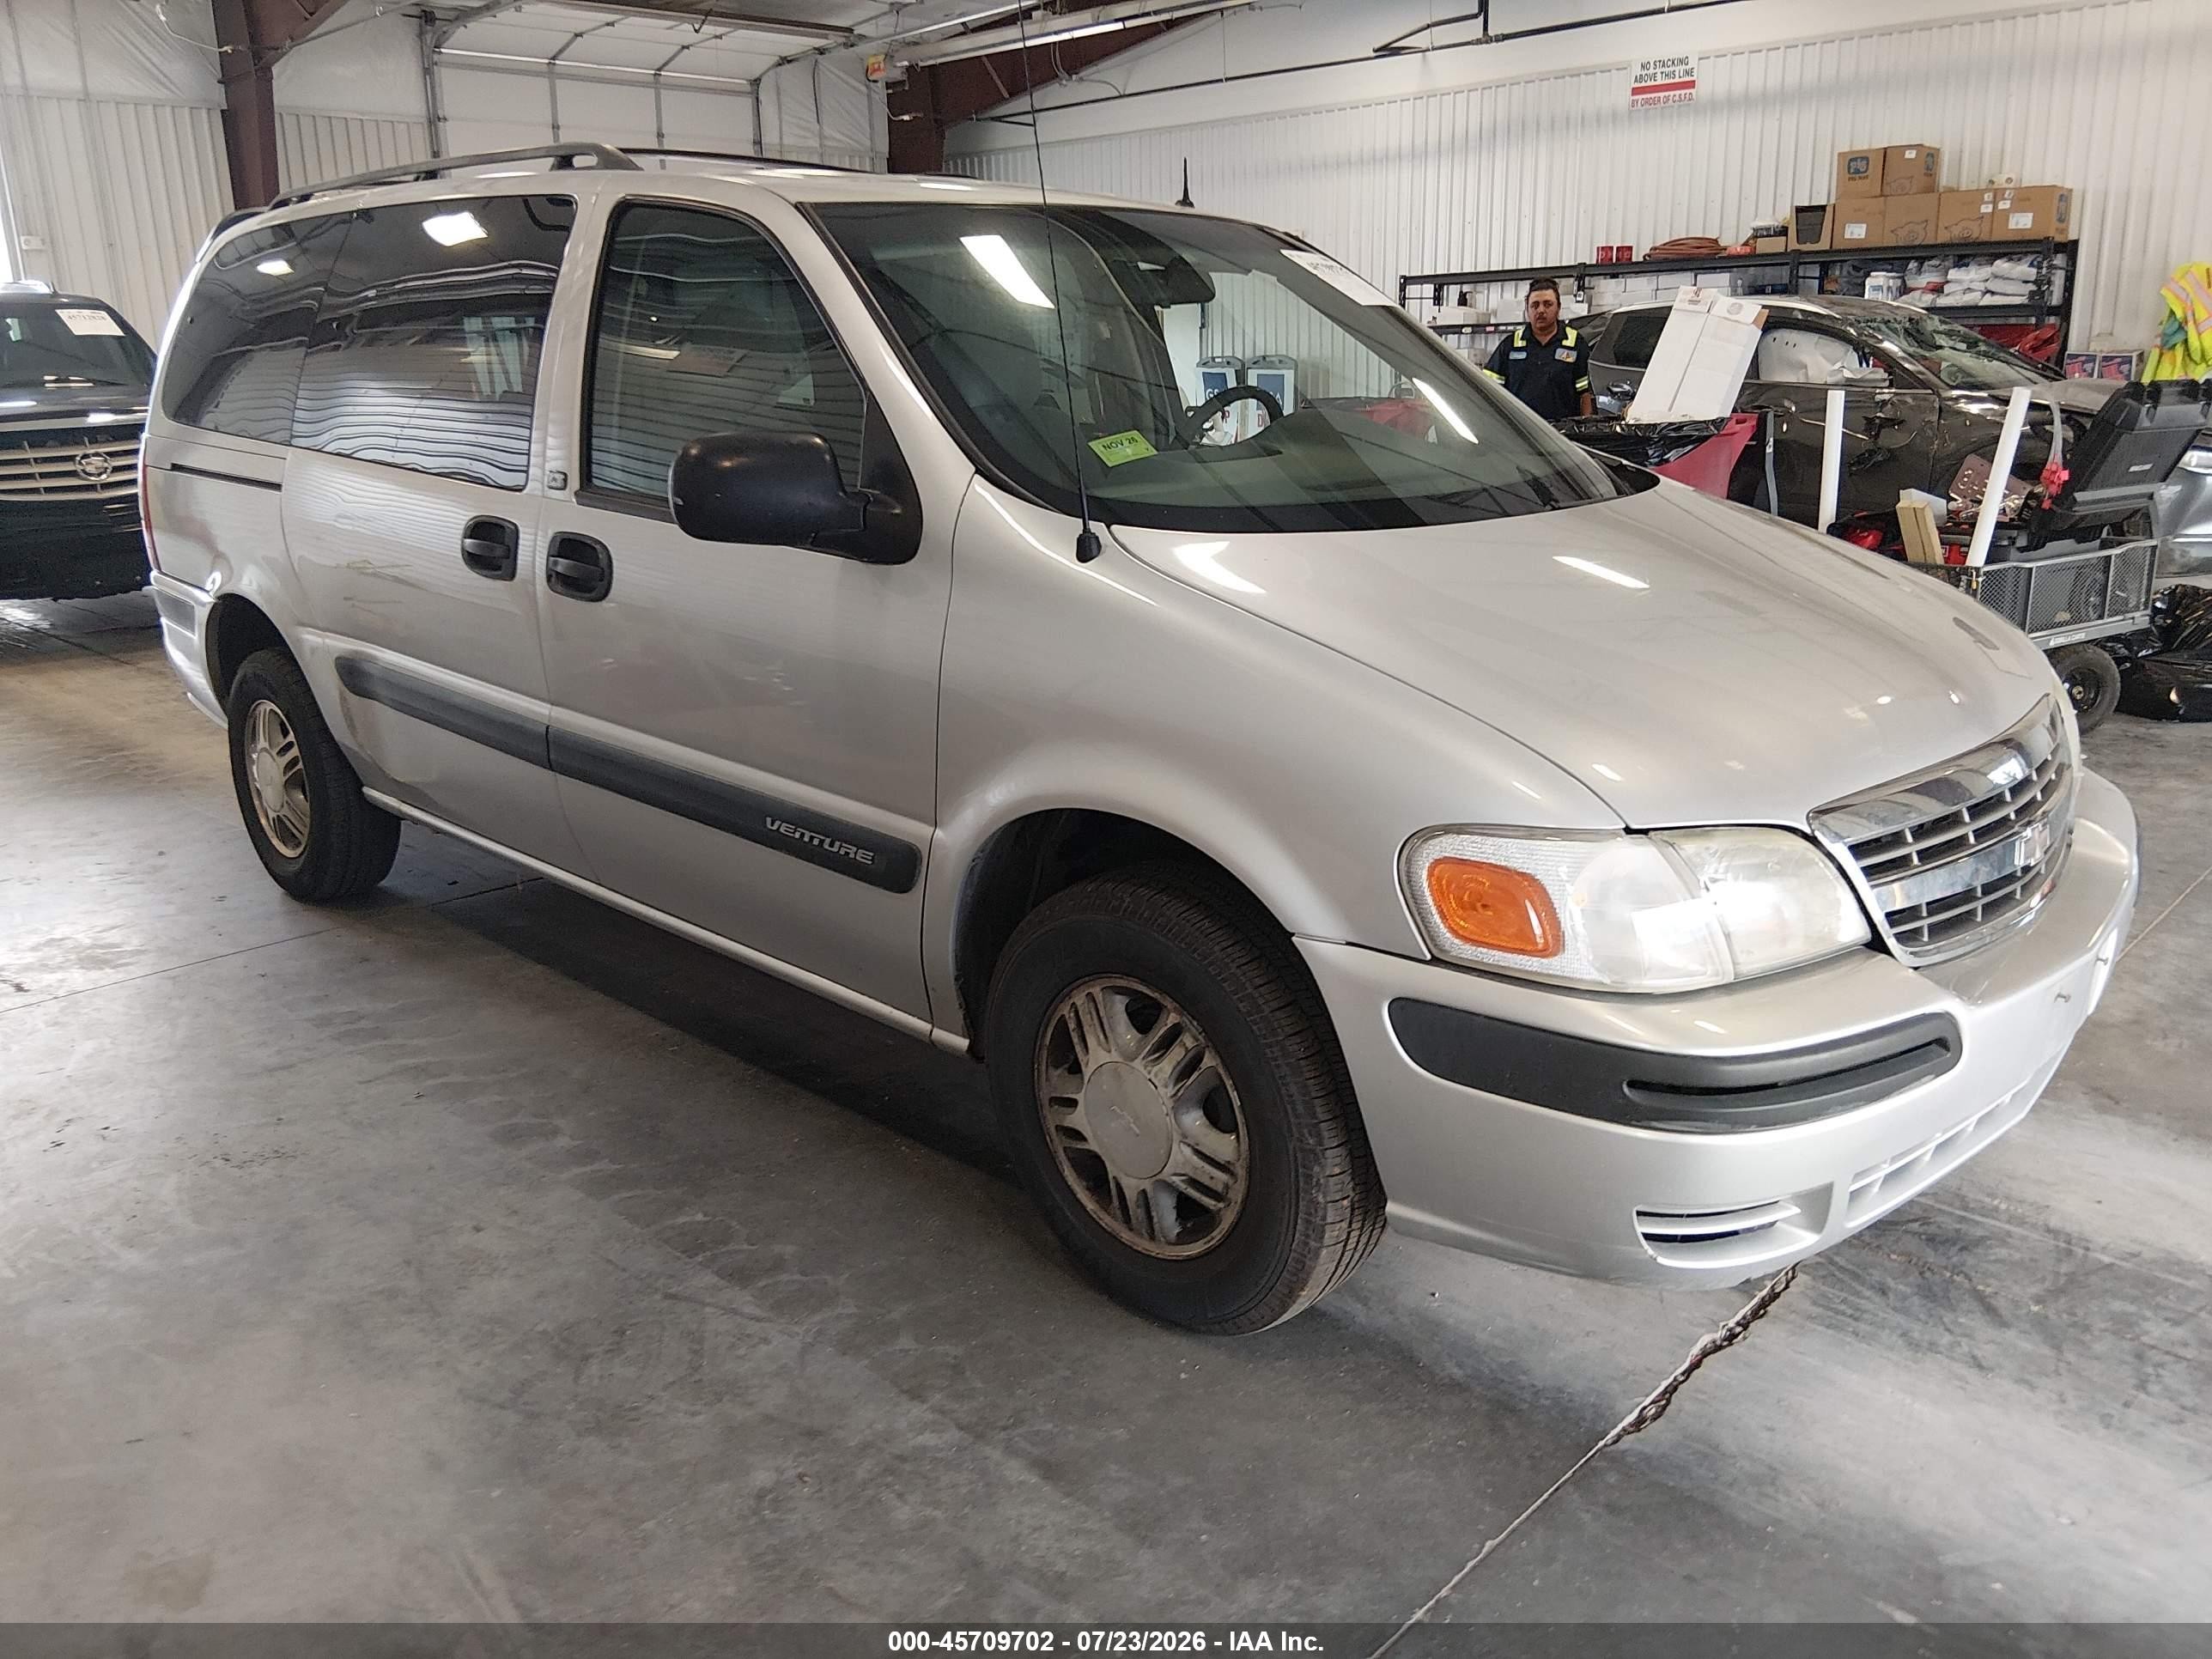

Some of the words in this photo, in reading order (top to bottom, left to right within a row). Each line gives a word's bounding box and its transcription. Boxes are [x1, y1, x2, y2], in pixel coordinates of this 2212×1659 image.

[1641, 61, 1651, 72] NO
[1653, 56, 1689, 70] STACKING
[1634, 73, 1657, 84] ABOVE
[1660, 70, 1676, 81] THIS
[1678, 67, 1695, 79] LINE
[1631, 98, 1639, 108] BY
[1641, 96, 1661, 106] ORDER
[1662, 95, 1671, 105] OF
[1672, 92, 1694, 103] C.S.F.D.
[1102, 439, 1124, 451] NOV
[765, 817, 875, 864] VENTURE
